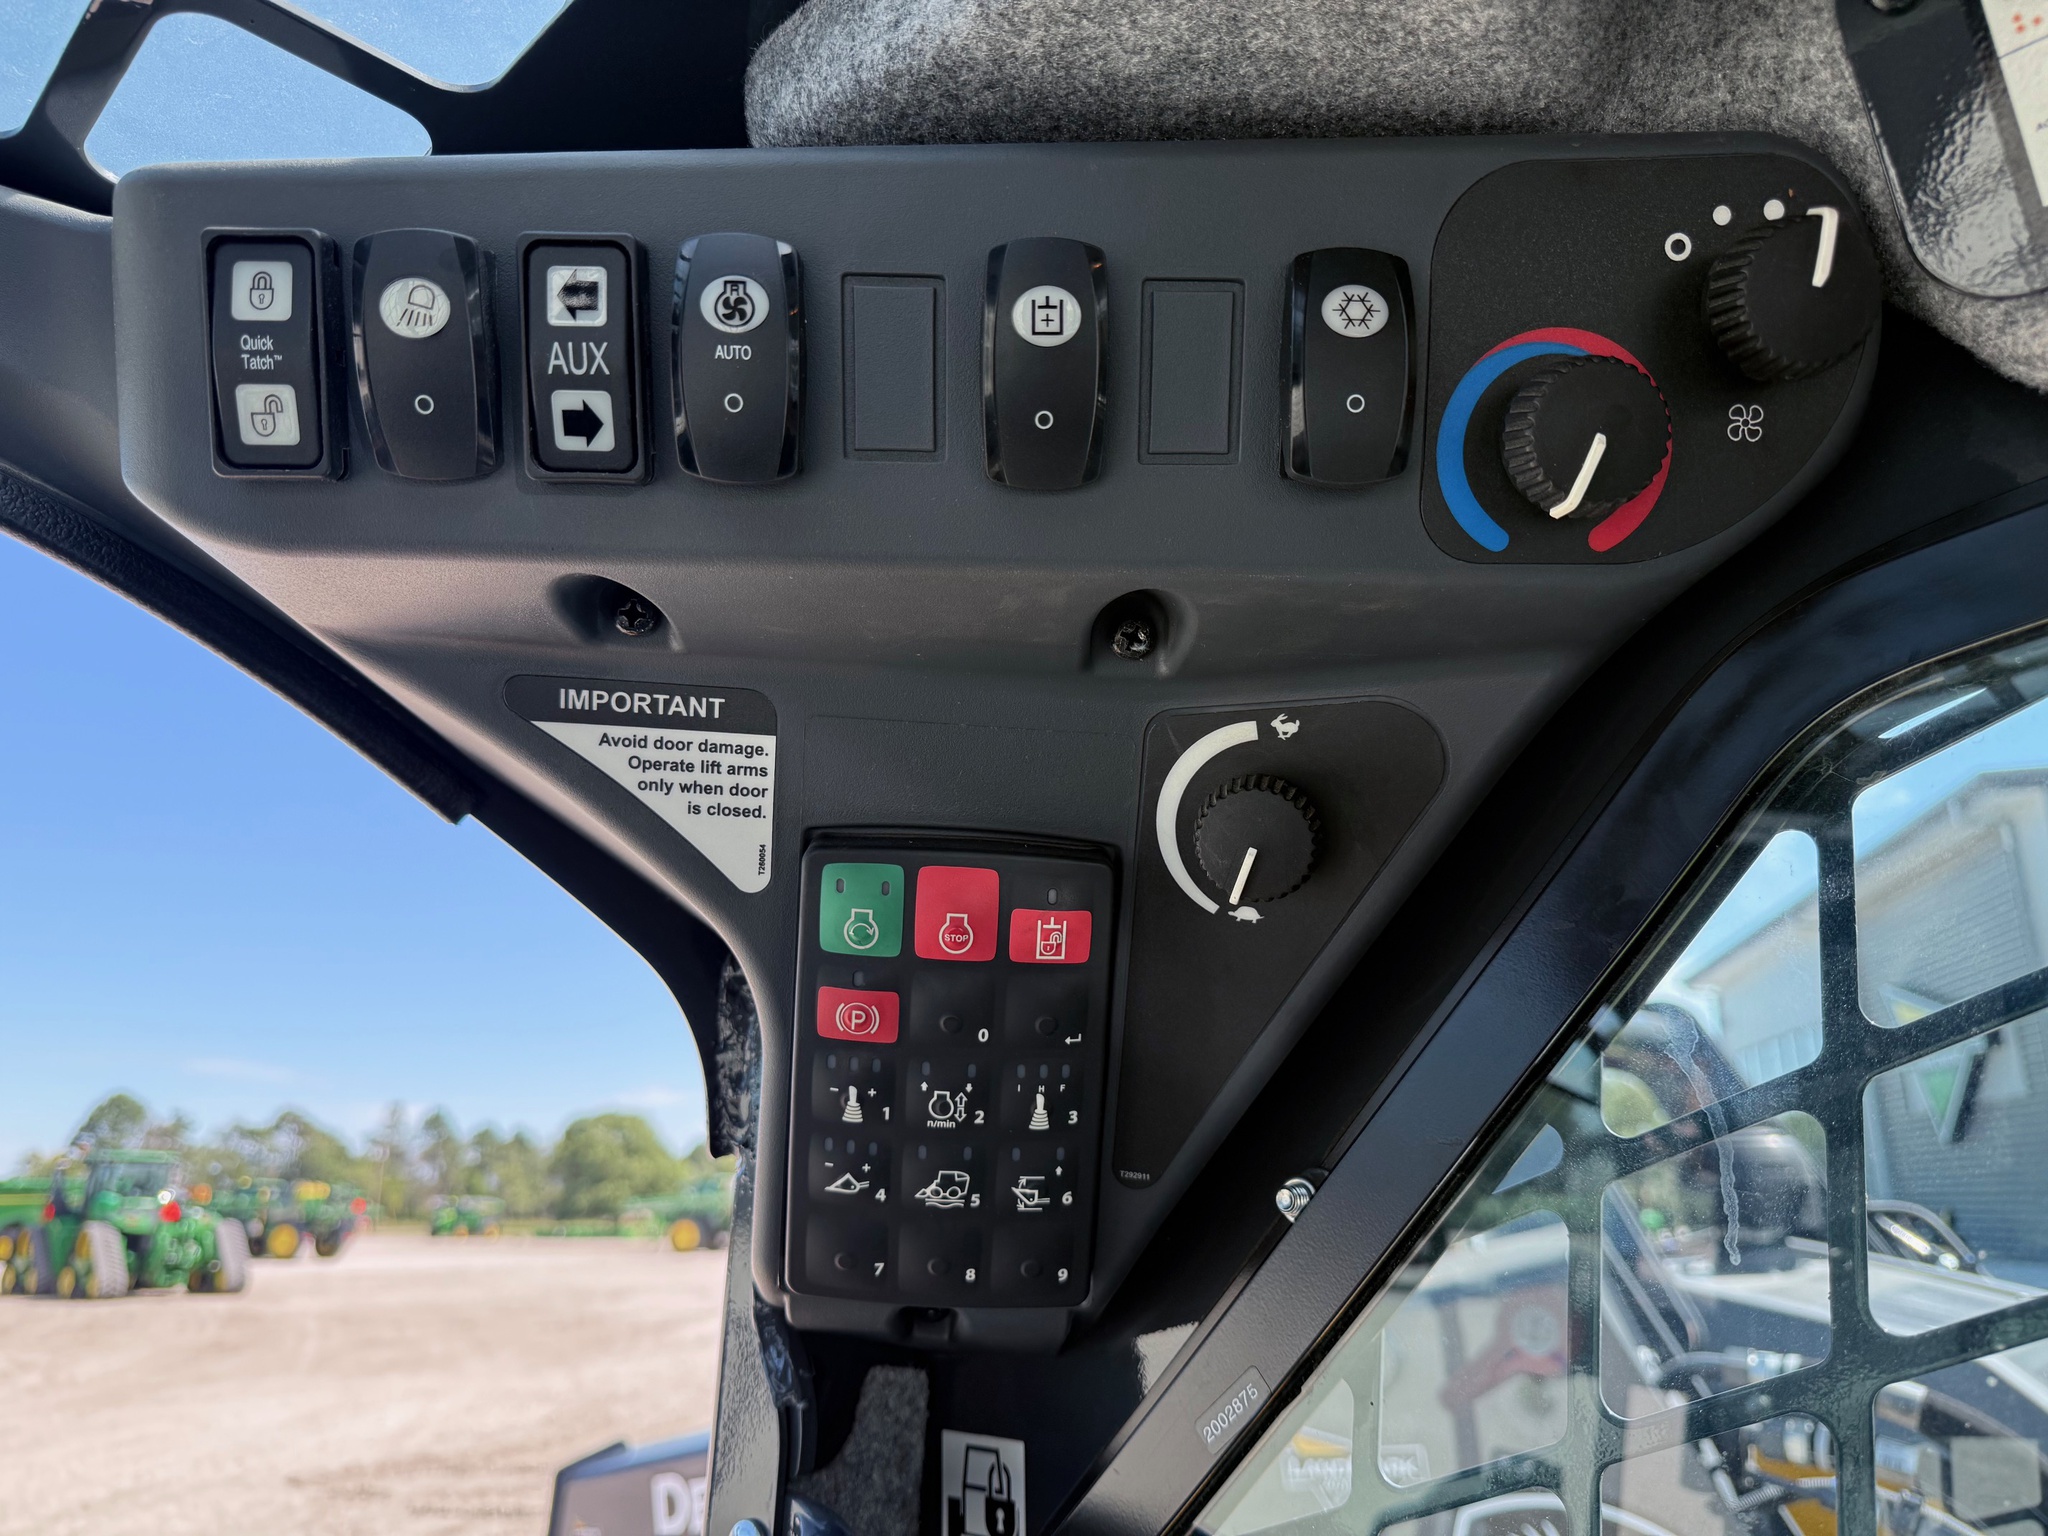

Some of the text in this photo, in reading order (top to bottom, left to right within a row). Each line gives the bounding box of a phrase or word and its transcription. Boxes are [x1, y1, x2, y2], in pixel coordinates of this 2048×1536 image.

[240, 334, 274, 351] Quick
[547, 340, 611, 376] AUX
[714, 344, 752, 361] AUTO
[558, 688, 726, 719] IMPORTANT
[598, 732, 769, 759] Avoid door damage.
[628, 755, 769, 778] Operate lift arms
[637, 777, 769, 798] only when door
[687, 801, 767, 819] is closed.
[758, 844, 766, 876] T260054
[944, 933, 969, 943] STOP
[851, 1010, 866, 1031] P
[978, 1028, 989, 1043] 0
[1038, 1085, 1045, 1093] H
[1060, 1084, 1066, 1092] F
[882, 1106, 890, 1121] 1
[974, 1110, 985, 1125] 2
[1068, 1110, 1078, 1124] 3
[927, 1118, 956, 1129] n/min
[875, 1187, 886, 1201] 4
[970, 1194, 981, 1207] 5
[1062, 1191, 1073, 1205] 6
[874, 1262, 885, 1276] 7
[965, 1268, 976, 1282] 8
[1057, 1268, 1069, 1282] 9
[1203, 1382, 1258, 1444] 2002875
